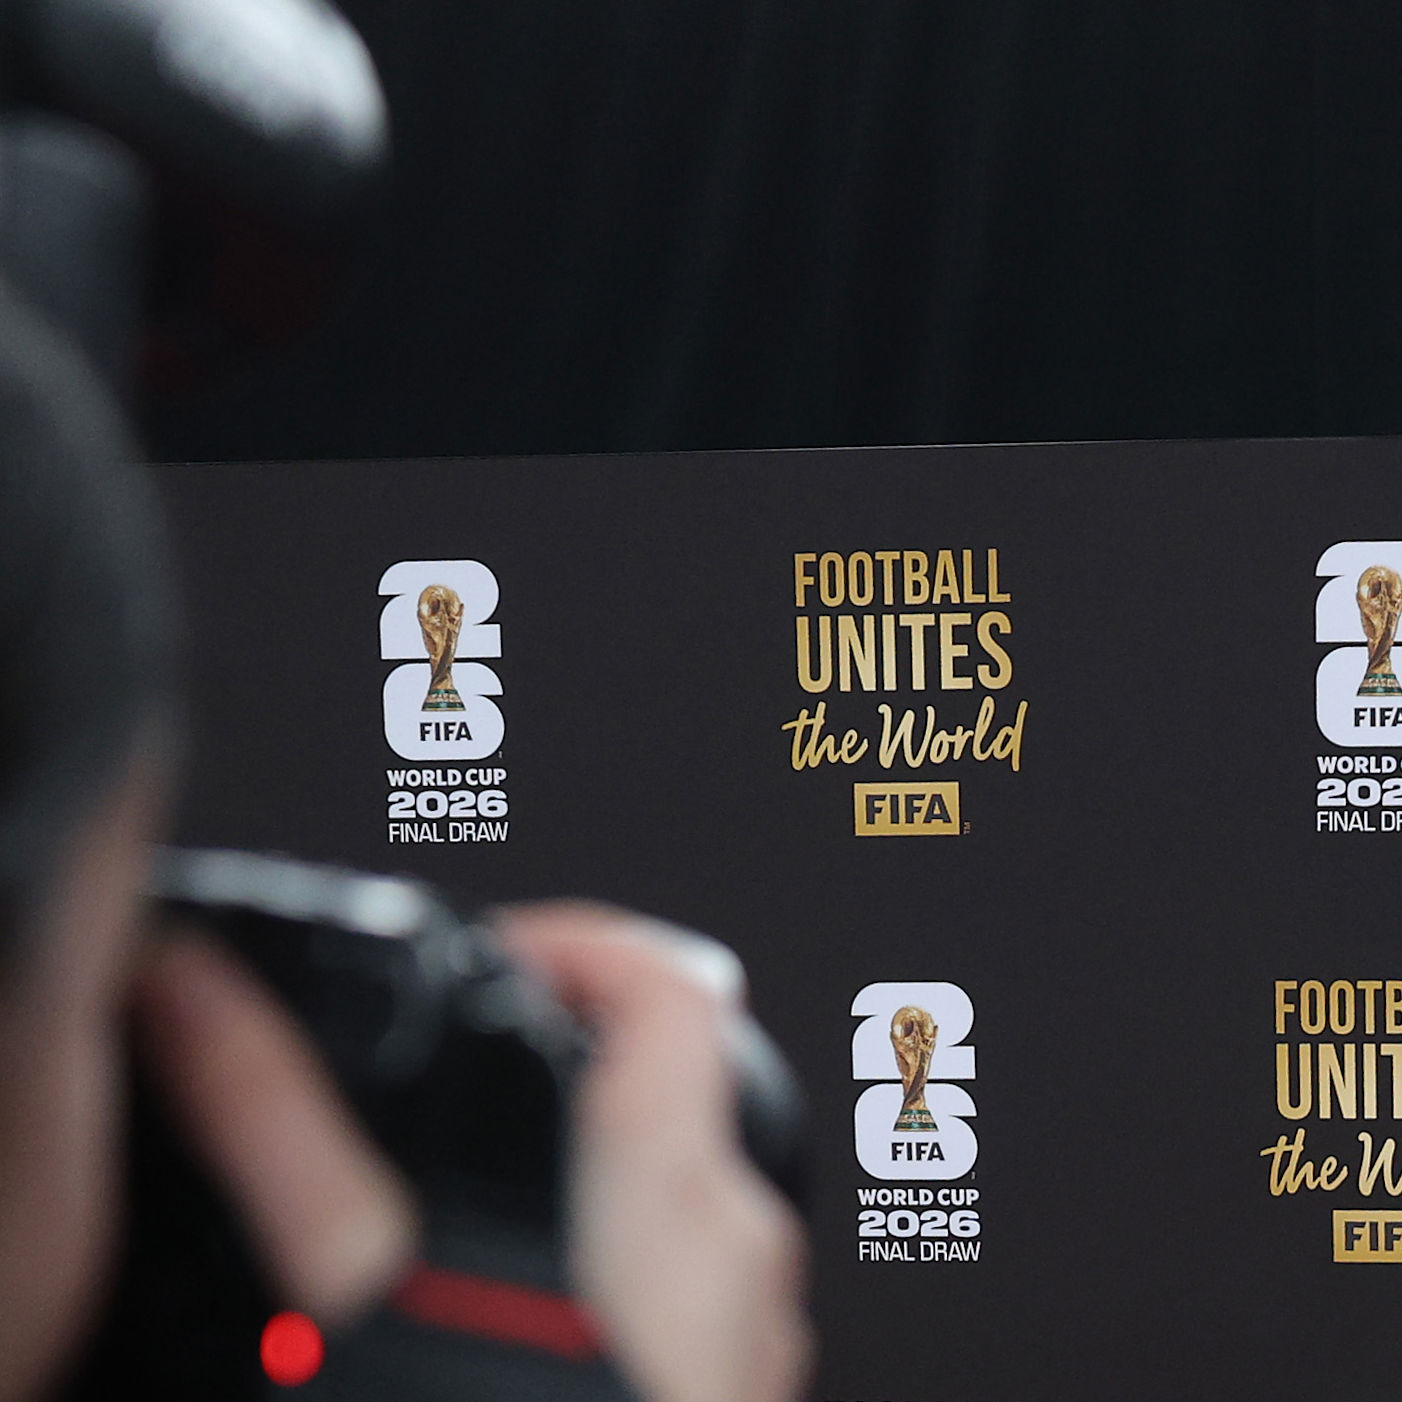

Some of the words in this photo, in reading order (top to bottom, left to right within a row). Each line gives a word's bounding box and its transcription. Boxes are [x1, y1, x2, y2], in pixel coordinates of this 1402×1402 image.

[795, 549, 1011, 607] FOOTBALL
[797, 611, 1012, 693] UNITES
[420, 722, 472, 741] FIFA
[782, 702, 868, 770] the
[878, 696, 1028, 771] World
[1317, 756, 1396, 773] WORLD
[387, 769, 462, 786] WORLD
[466, 769, 506, 785] CUP
[388, 790, 508, 818] 2026
[866, 794, 952, 824] FIFA
[1317, 811, 1376, 831] FINAL
[389, 823, 444, 842] FINAL
[449, 822, 508, 842] DRAW
[892, 1142, 944, 1160] FIFA
[1260, 1128, 1348, 1196] the
[858, 1189, 933, 1205] WORLD
[937, 1189, 979, 1205] CUP
[858, 1210, 980, 1237] 2026
[859, 1241, 915, 1261] FINAL
[920, 1242, 980, 1261] DRAW
